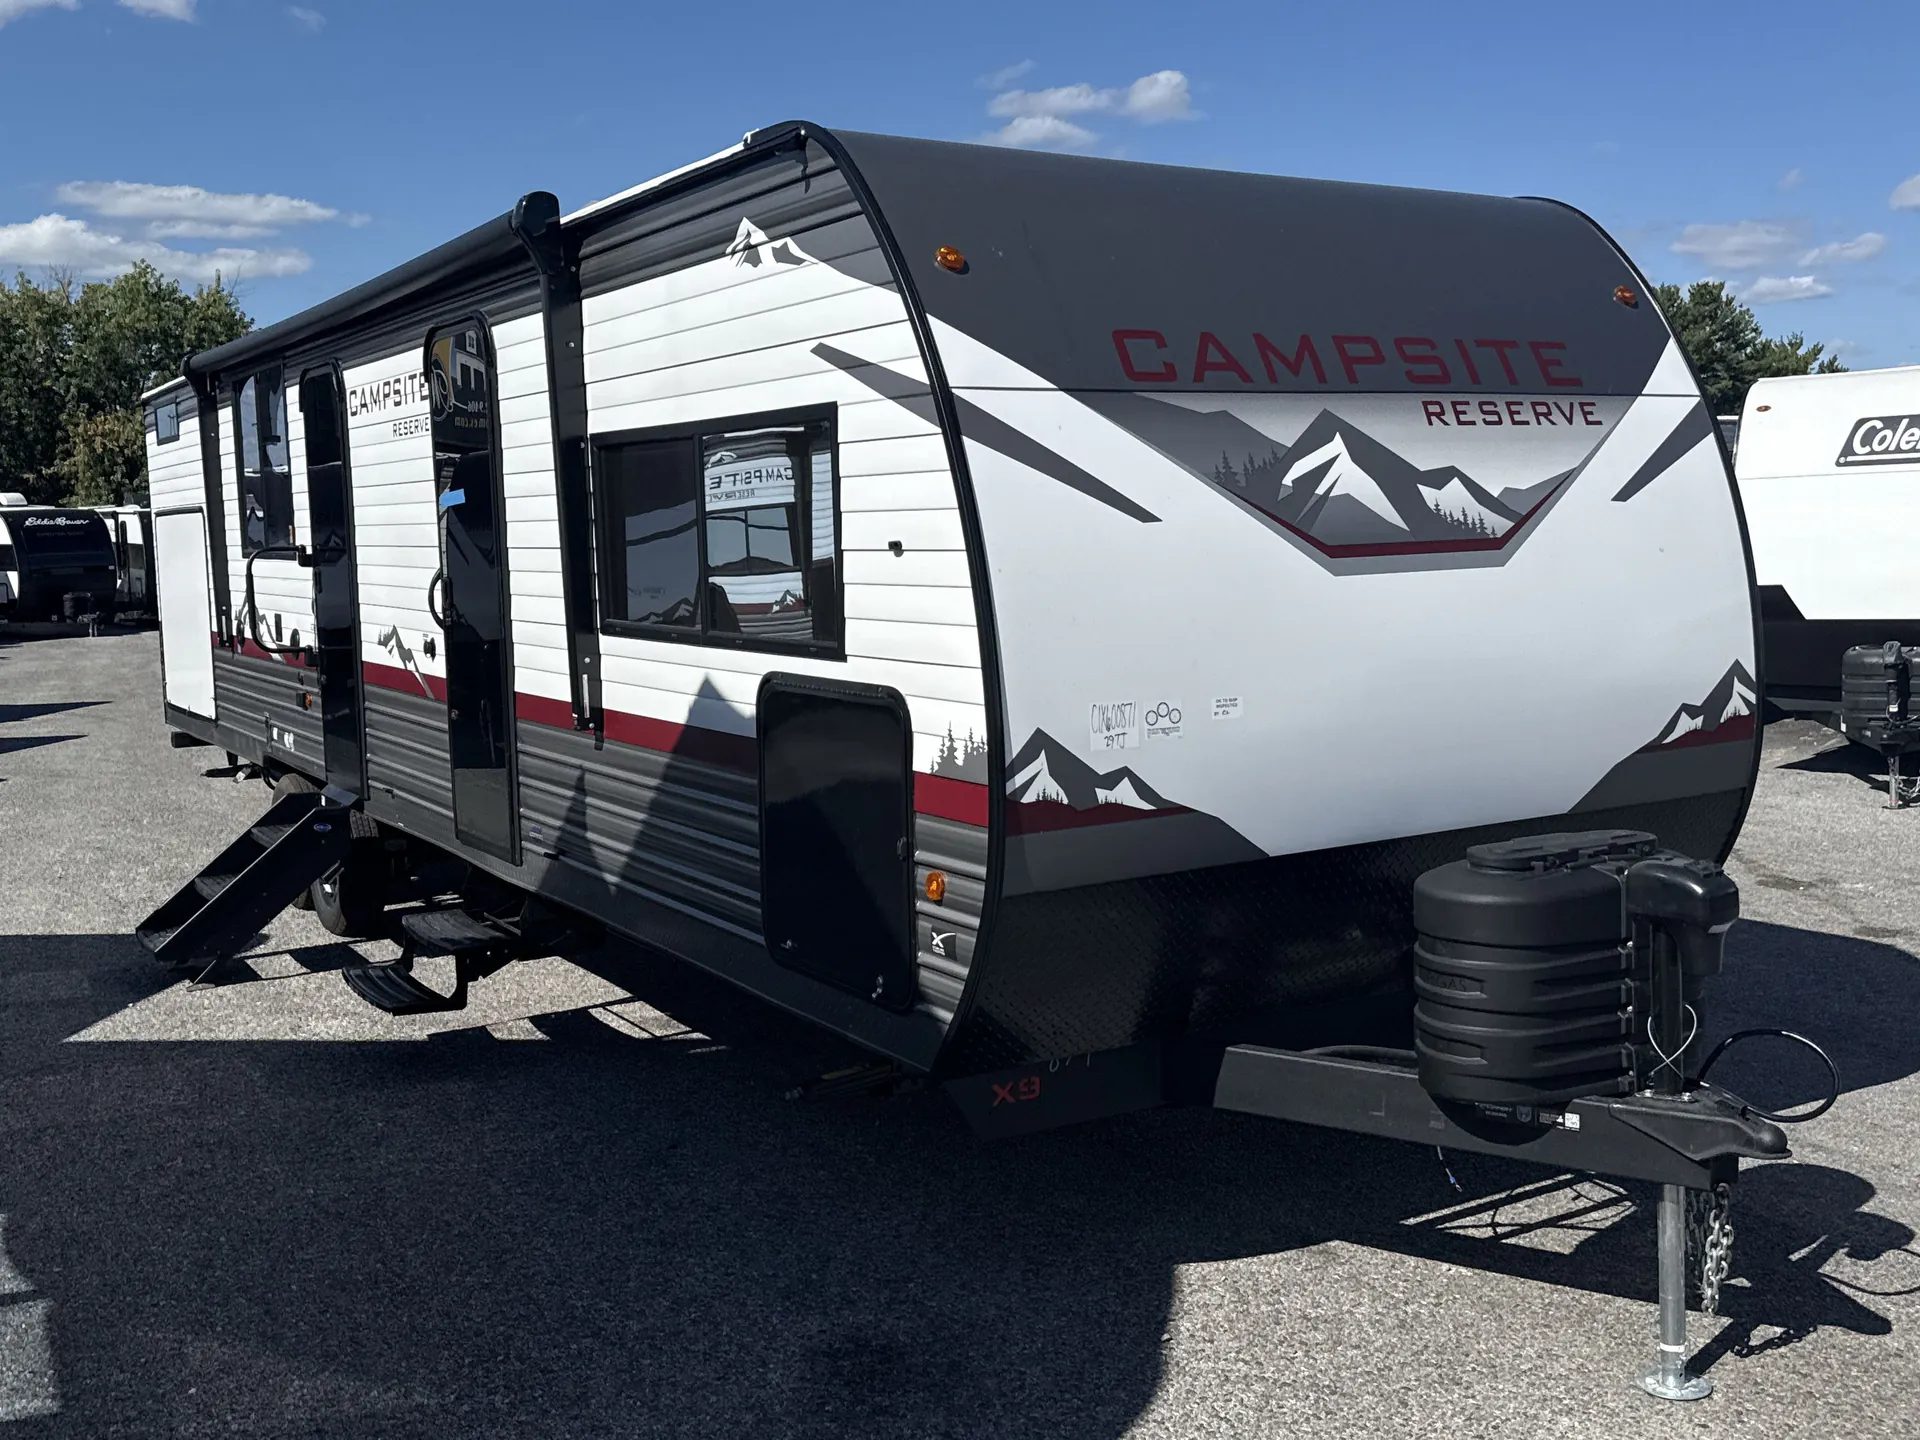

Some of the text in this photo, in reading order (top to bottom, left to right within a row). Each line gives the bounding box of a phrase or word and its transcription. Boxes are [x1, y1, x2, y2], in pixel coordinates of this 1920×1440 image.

[1111, 329, 1583, 388] CAMPSITE
[349, 371, 429, 417] CAMPSITE
[392, 416, 430, 438] RESERVE
[1421, 400, 1604, 427] RESERVE
[1852, 418, 1920, 455] Cole
[23, 516, 90, 528] Eddie Bauer
